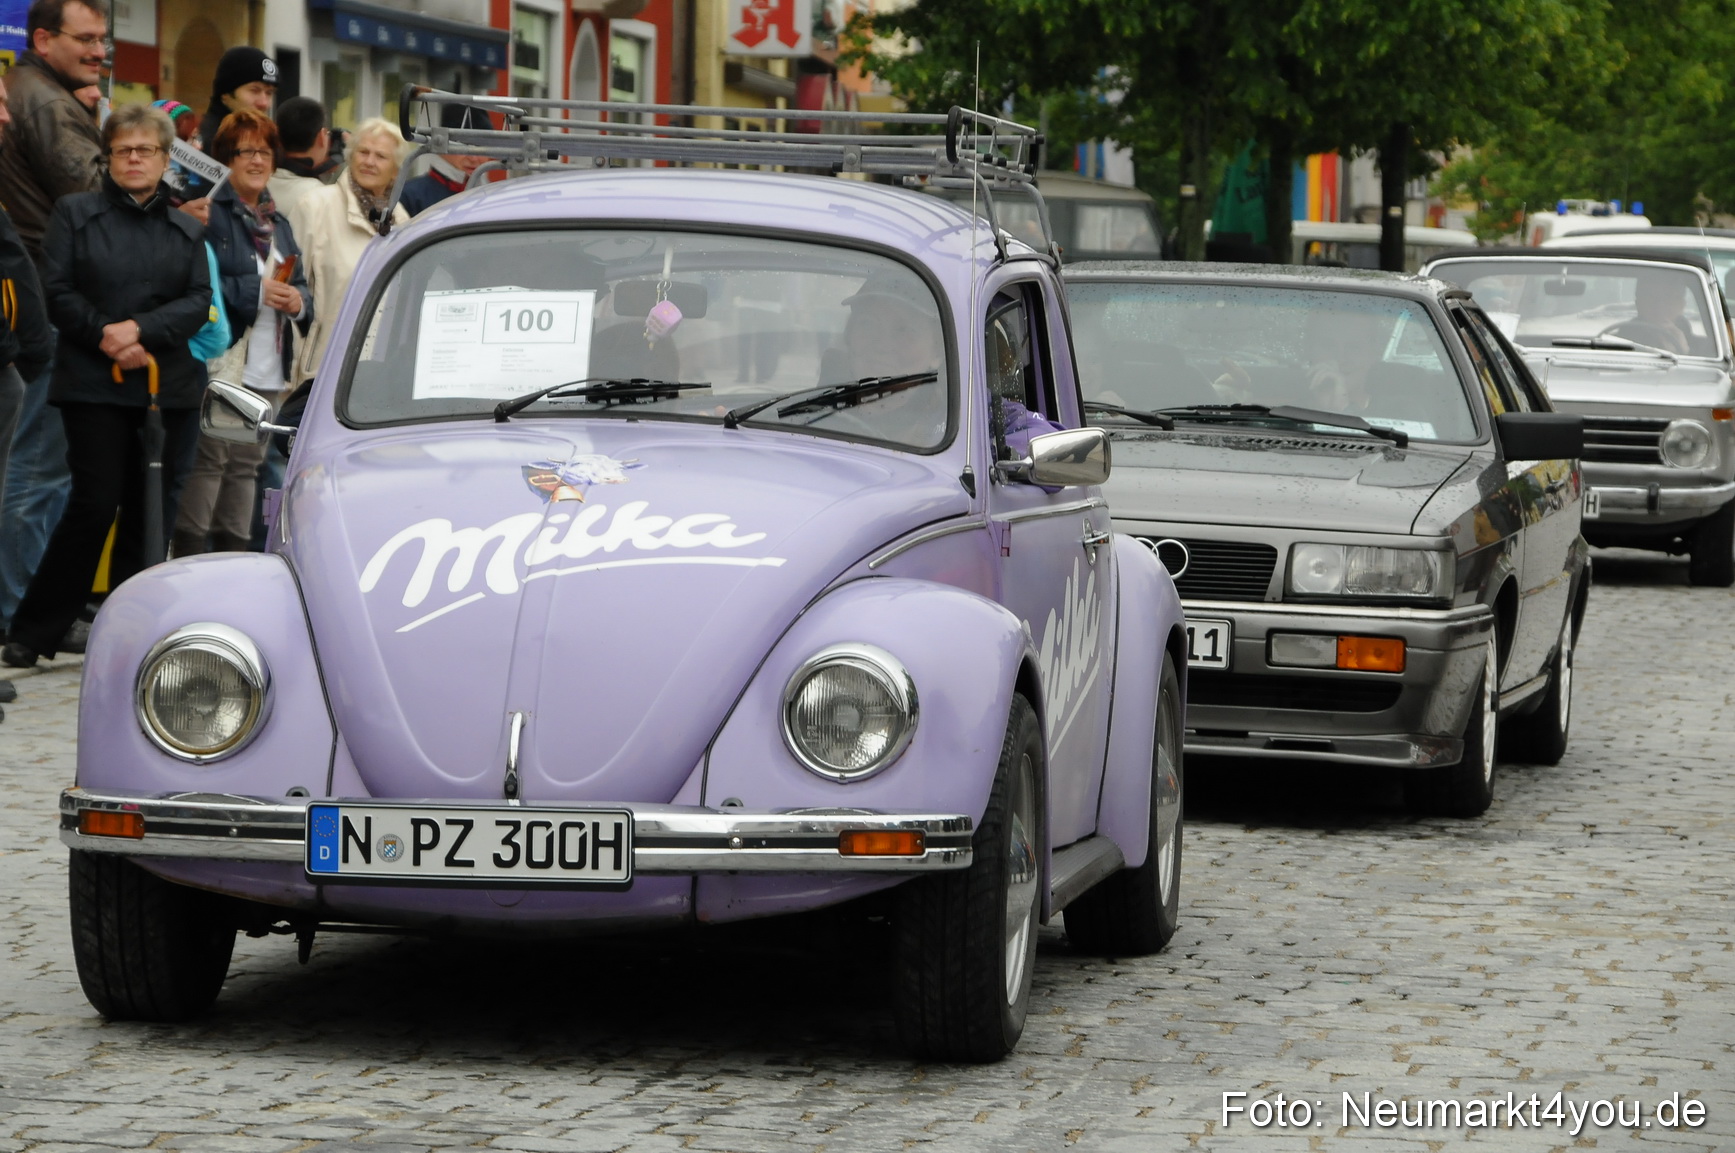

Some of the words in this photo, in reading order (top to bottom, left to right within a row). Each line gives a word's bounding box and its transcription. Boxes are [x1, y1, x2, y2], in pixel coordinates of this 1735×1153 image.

[170, 145, 224, 179] MEILENSTEIN
[499, 309, 553, 332] 100
[1586, 494, 1597, 513] H
[359, 500, 766, 608] Milka
[1187, 627, 1222, 661] 11
[319, 846, 330, 860] D
[342, 815, 372, 864] N
[411, 817, 475, 868] PZ
[492, 819, 622, 870] 300H
